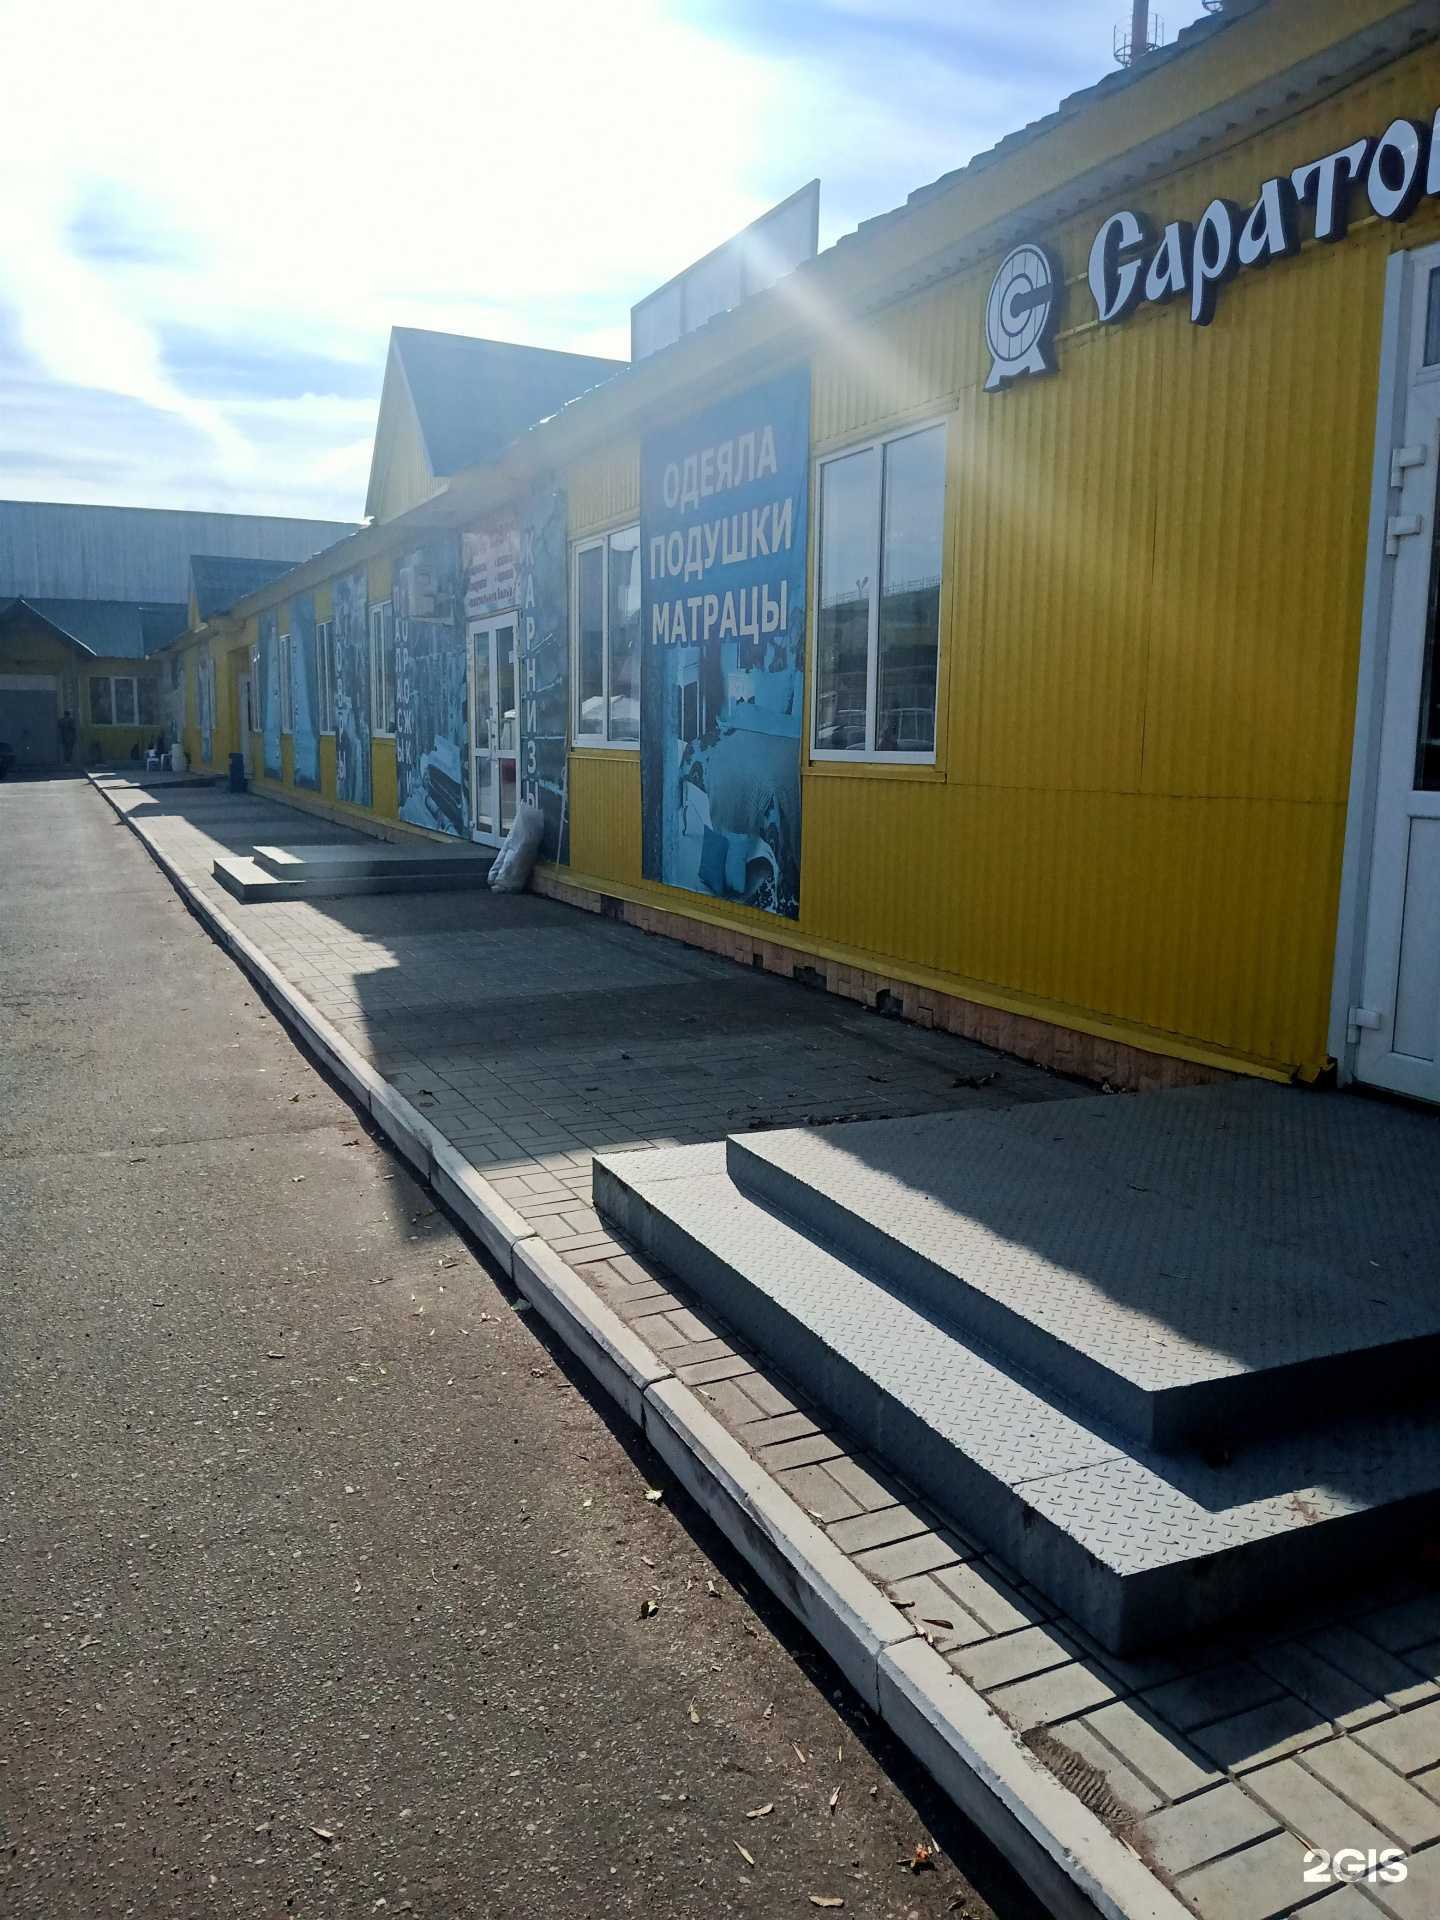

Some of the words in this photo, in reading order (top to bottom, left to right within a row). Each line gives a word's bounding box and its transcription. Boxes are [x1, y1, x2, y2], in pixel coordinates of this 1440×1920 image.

[663, 425, 777, 514] ОДЕЯЛА
[651, 498, 793, 583] ПОДУШКИ
[652, 580, 788, 645] МАТРАЦЫ
[521, 528, 540, 809] КАРНИЗЫ
